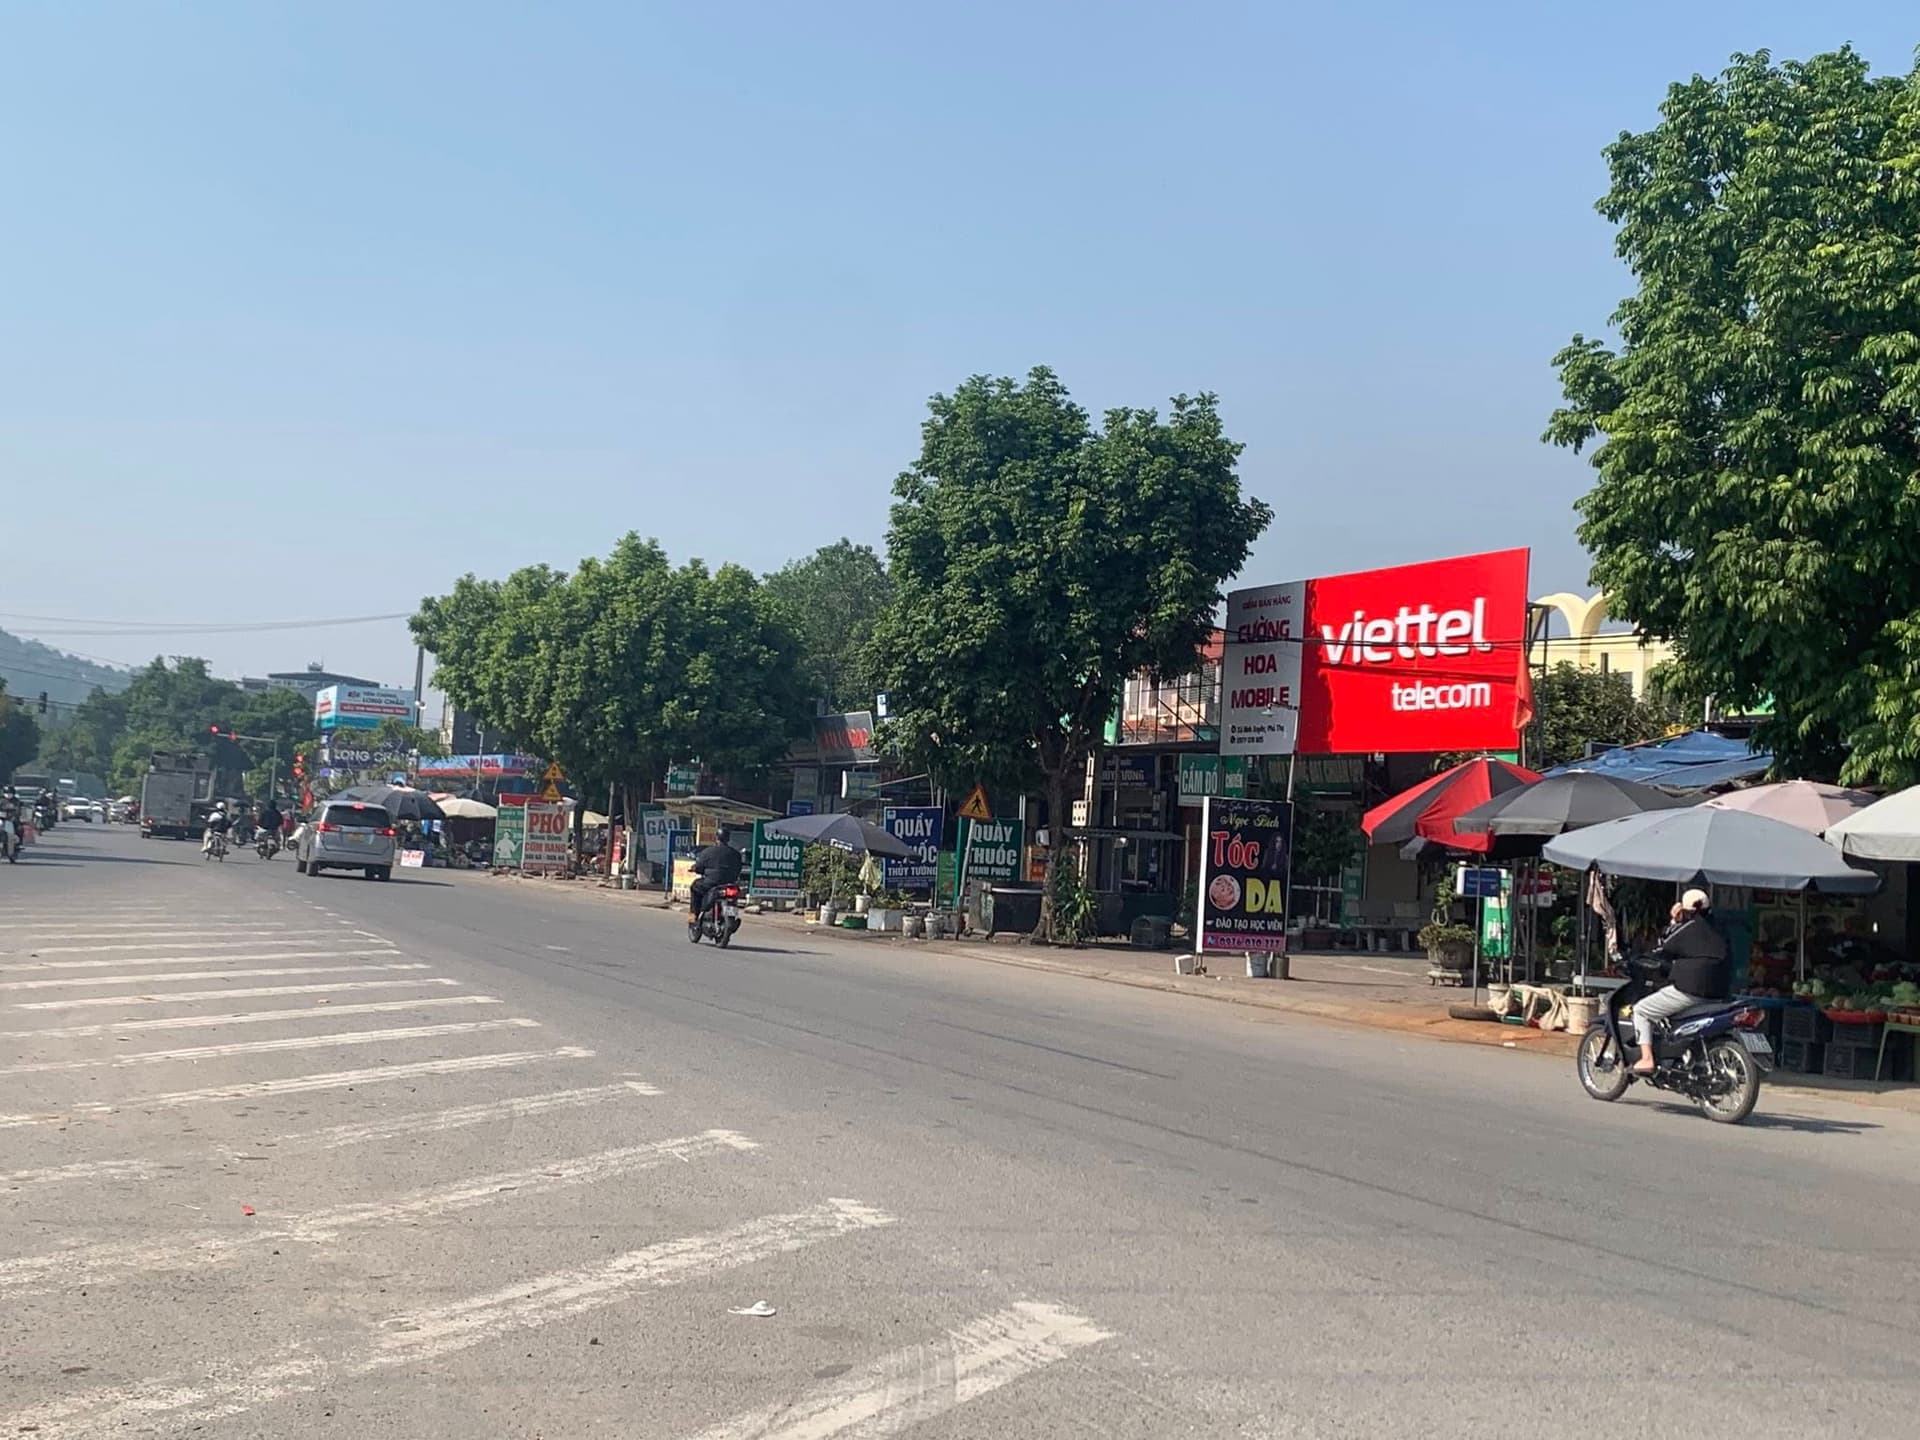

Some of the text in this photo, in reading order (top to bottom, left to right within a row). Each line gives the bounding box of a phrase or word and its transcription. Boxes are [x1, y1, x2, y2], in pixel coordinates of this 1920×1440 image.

[1238, 615, 1290, 642] CƯỜNG
[1321, 597, 1492, 665] viettel
[1244, 653, 1277, 675] HOA
[1231, 686, 1290, 709] MOBILE
[1392, 680, 1491, 711] telecom
[333, 750, 370, 762] LONG
[528, 805, 567, 834] PHỞ
[758, 841, 800, 861] THUỐC
[1245, 878, 1283, 914] DA
[1215, 917, 1283, 931] ĐÀO TẠO HỌC VIÊN
